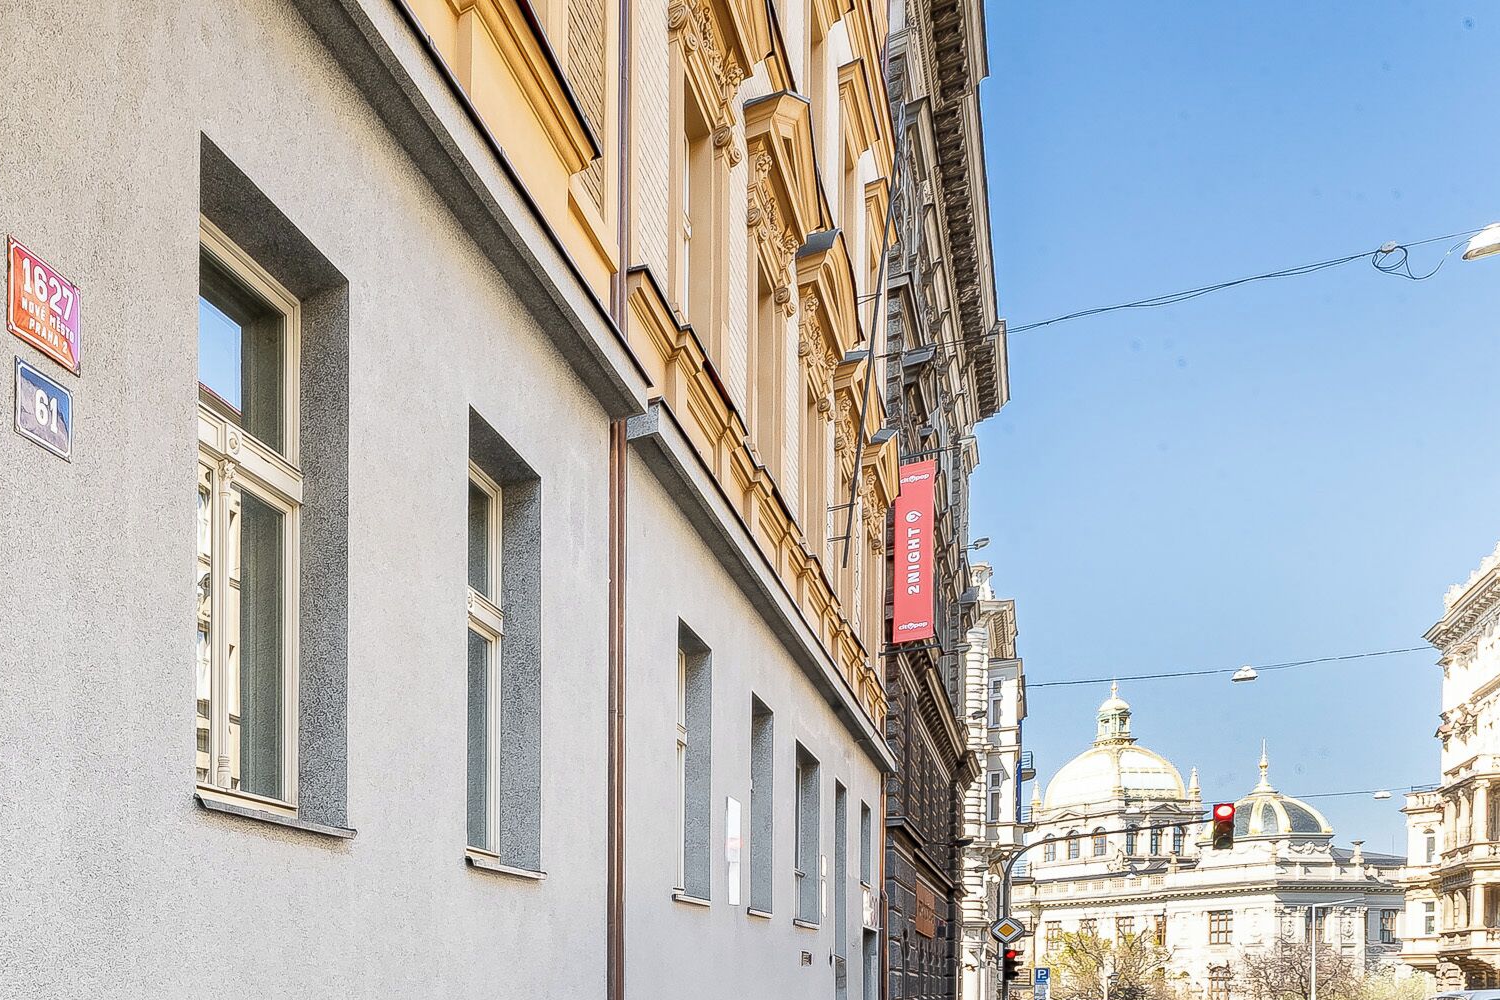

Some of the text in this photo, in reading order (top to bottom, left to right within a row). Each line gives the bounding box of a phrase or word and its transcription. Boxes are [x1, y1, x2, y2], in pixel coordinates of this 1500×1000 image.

[21, 297, 46, 320] NOVÉ
[22, 258, 74, 321] 1627
[28, 318, 68, 354] PRAHA 2
[35, 389, 57, 434] 61
[907, 528, 921, 595] 2NIGHT
[1037, 969, 1047, 979] P
